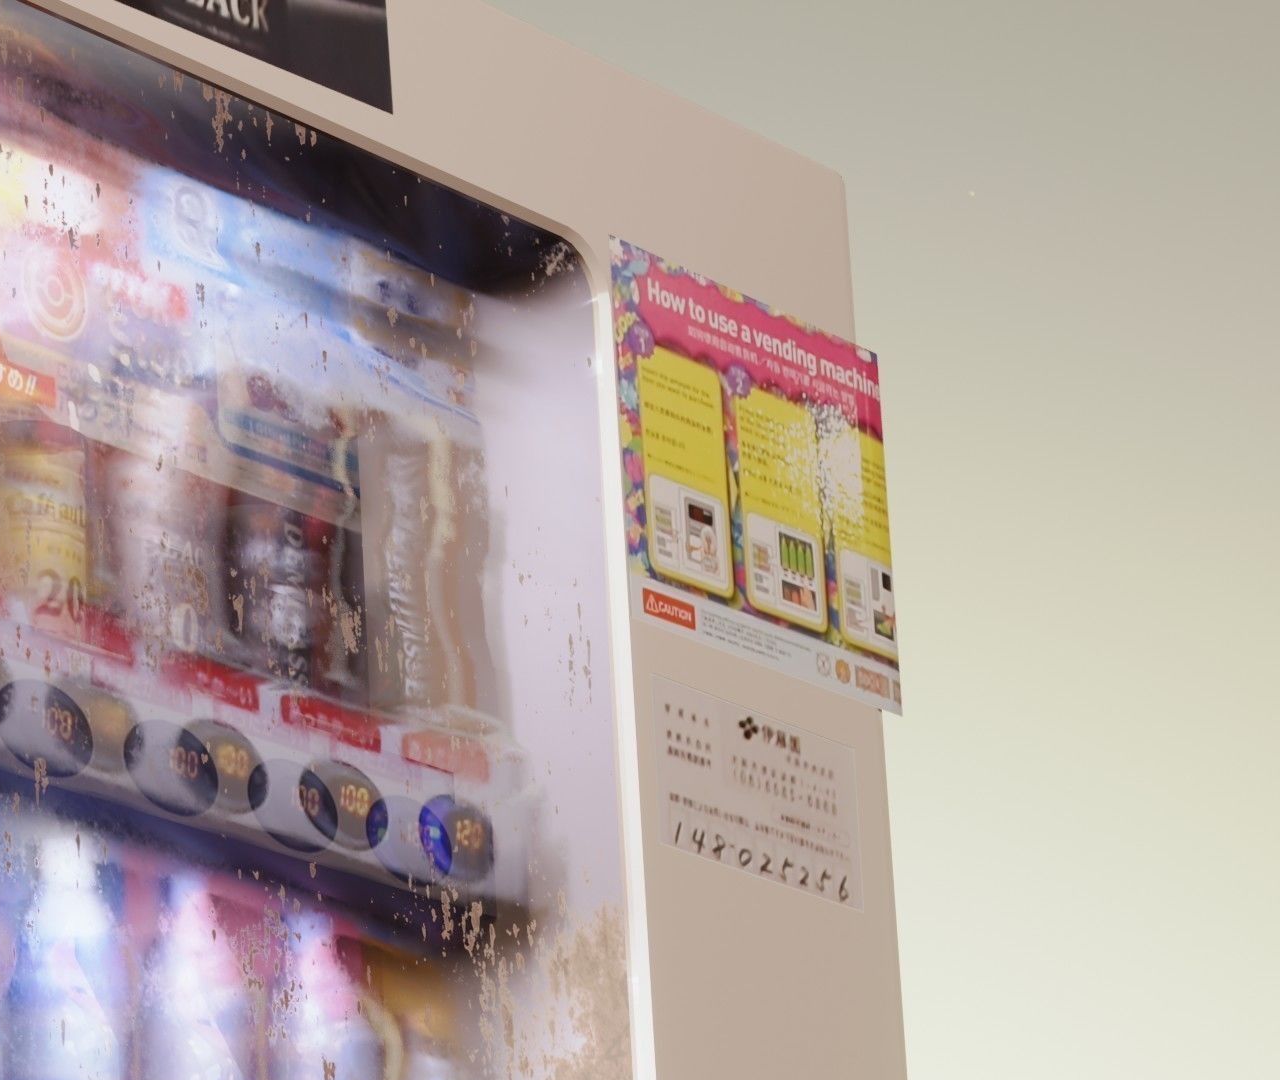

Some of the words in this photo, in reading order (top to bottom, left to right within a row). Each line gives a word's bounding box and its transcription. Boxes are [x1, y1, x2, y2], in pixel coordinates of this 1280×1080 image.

[189, 0, 269, 32] ACK
[647, 277, 686, 316] How
[689, 298, 706, 323] to
[708, 311, 738, 338] use
[741, 326, 752, 344] a
[753, 328, 817, 376] vending
[658, 601, 692, 623] CAUTION
